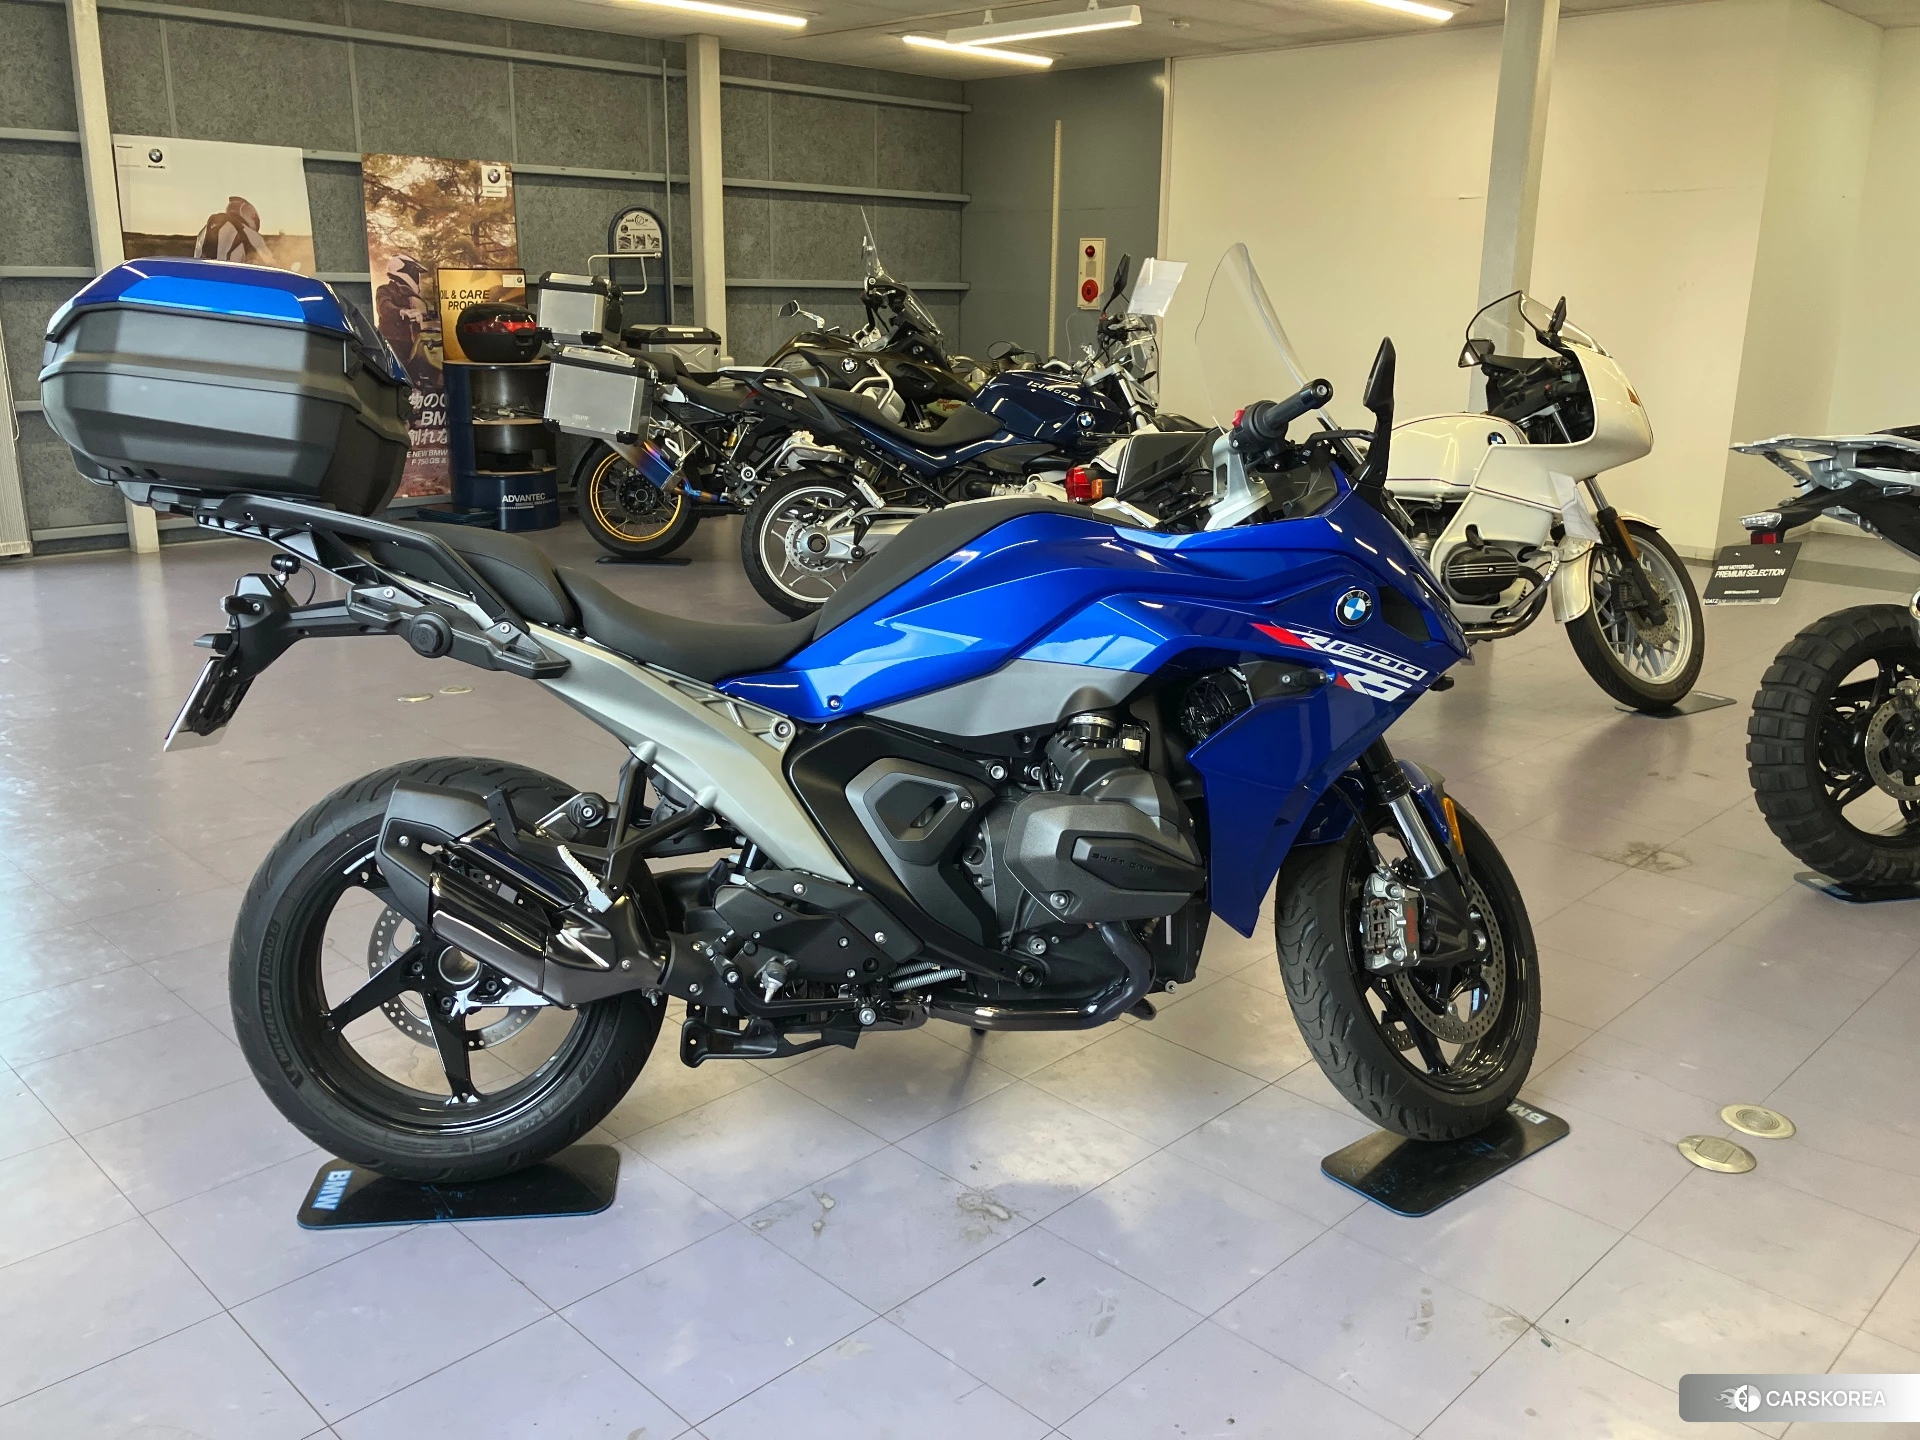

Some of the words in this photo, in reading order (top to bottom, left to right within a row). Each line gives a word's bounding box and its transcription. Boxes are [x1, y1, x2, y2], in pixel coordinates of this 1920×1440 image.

[451, 290, 457, 299] &
[460, 289, 490, 300] CARE
[502, 493, 546, 502] ADVANTEC
[1714, 570, 1746, 578] PREMIUM
[1746, 568, 1786, 577] SELECTION
[1345, 591, 1372, 607] BMW
[1329, 659, 1412, 702] RS
[1092, 852, 1125, 865] SHIFT
[261, 937, 275, 976] ROAD
[260, 986, 289, 1062] MICHELIN
[311, 1170, 352, 1211] BMW
